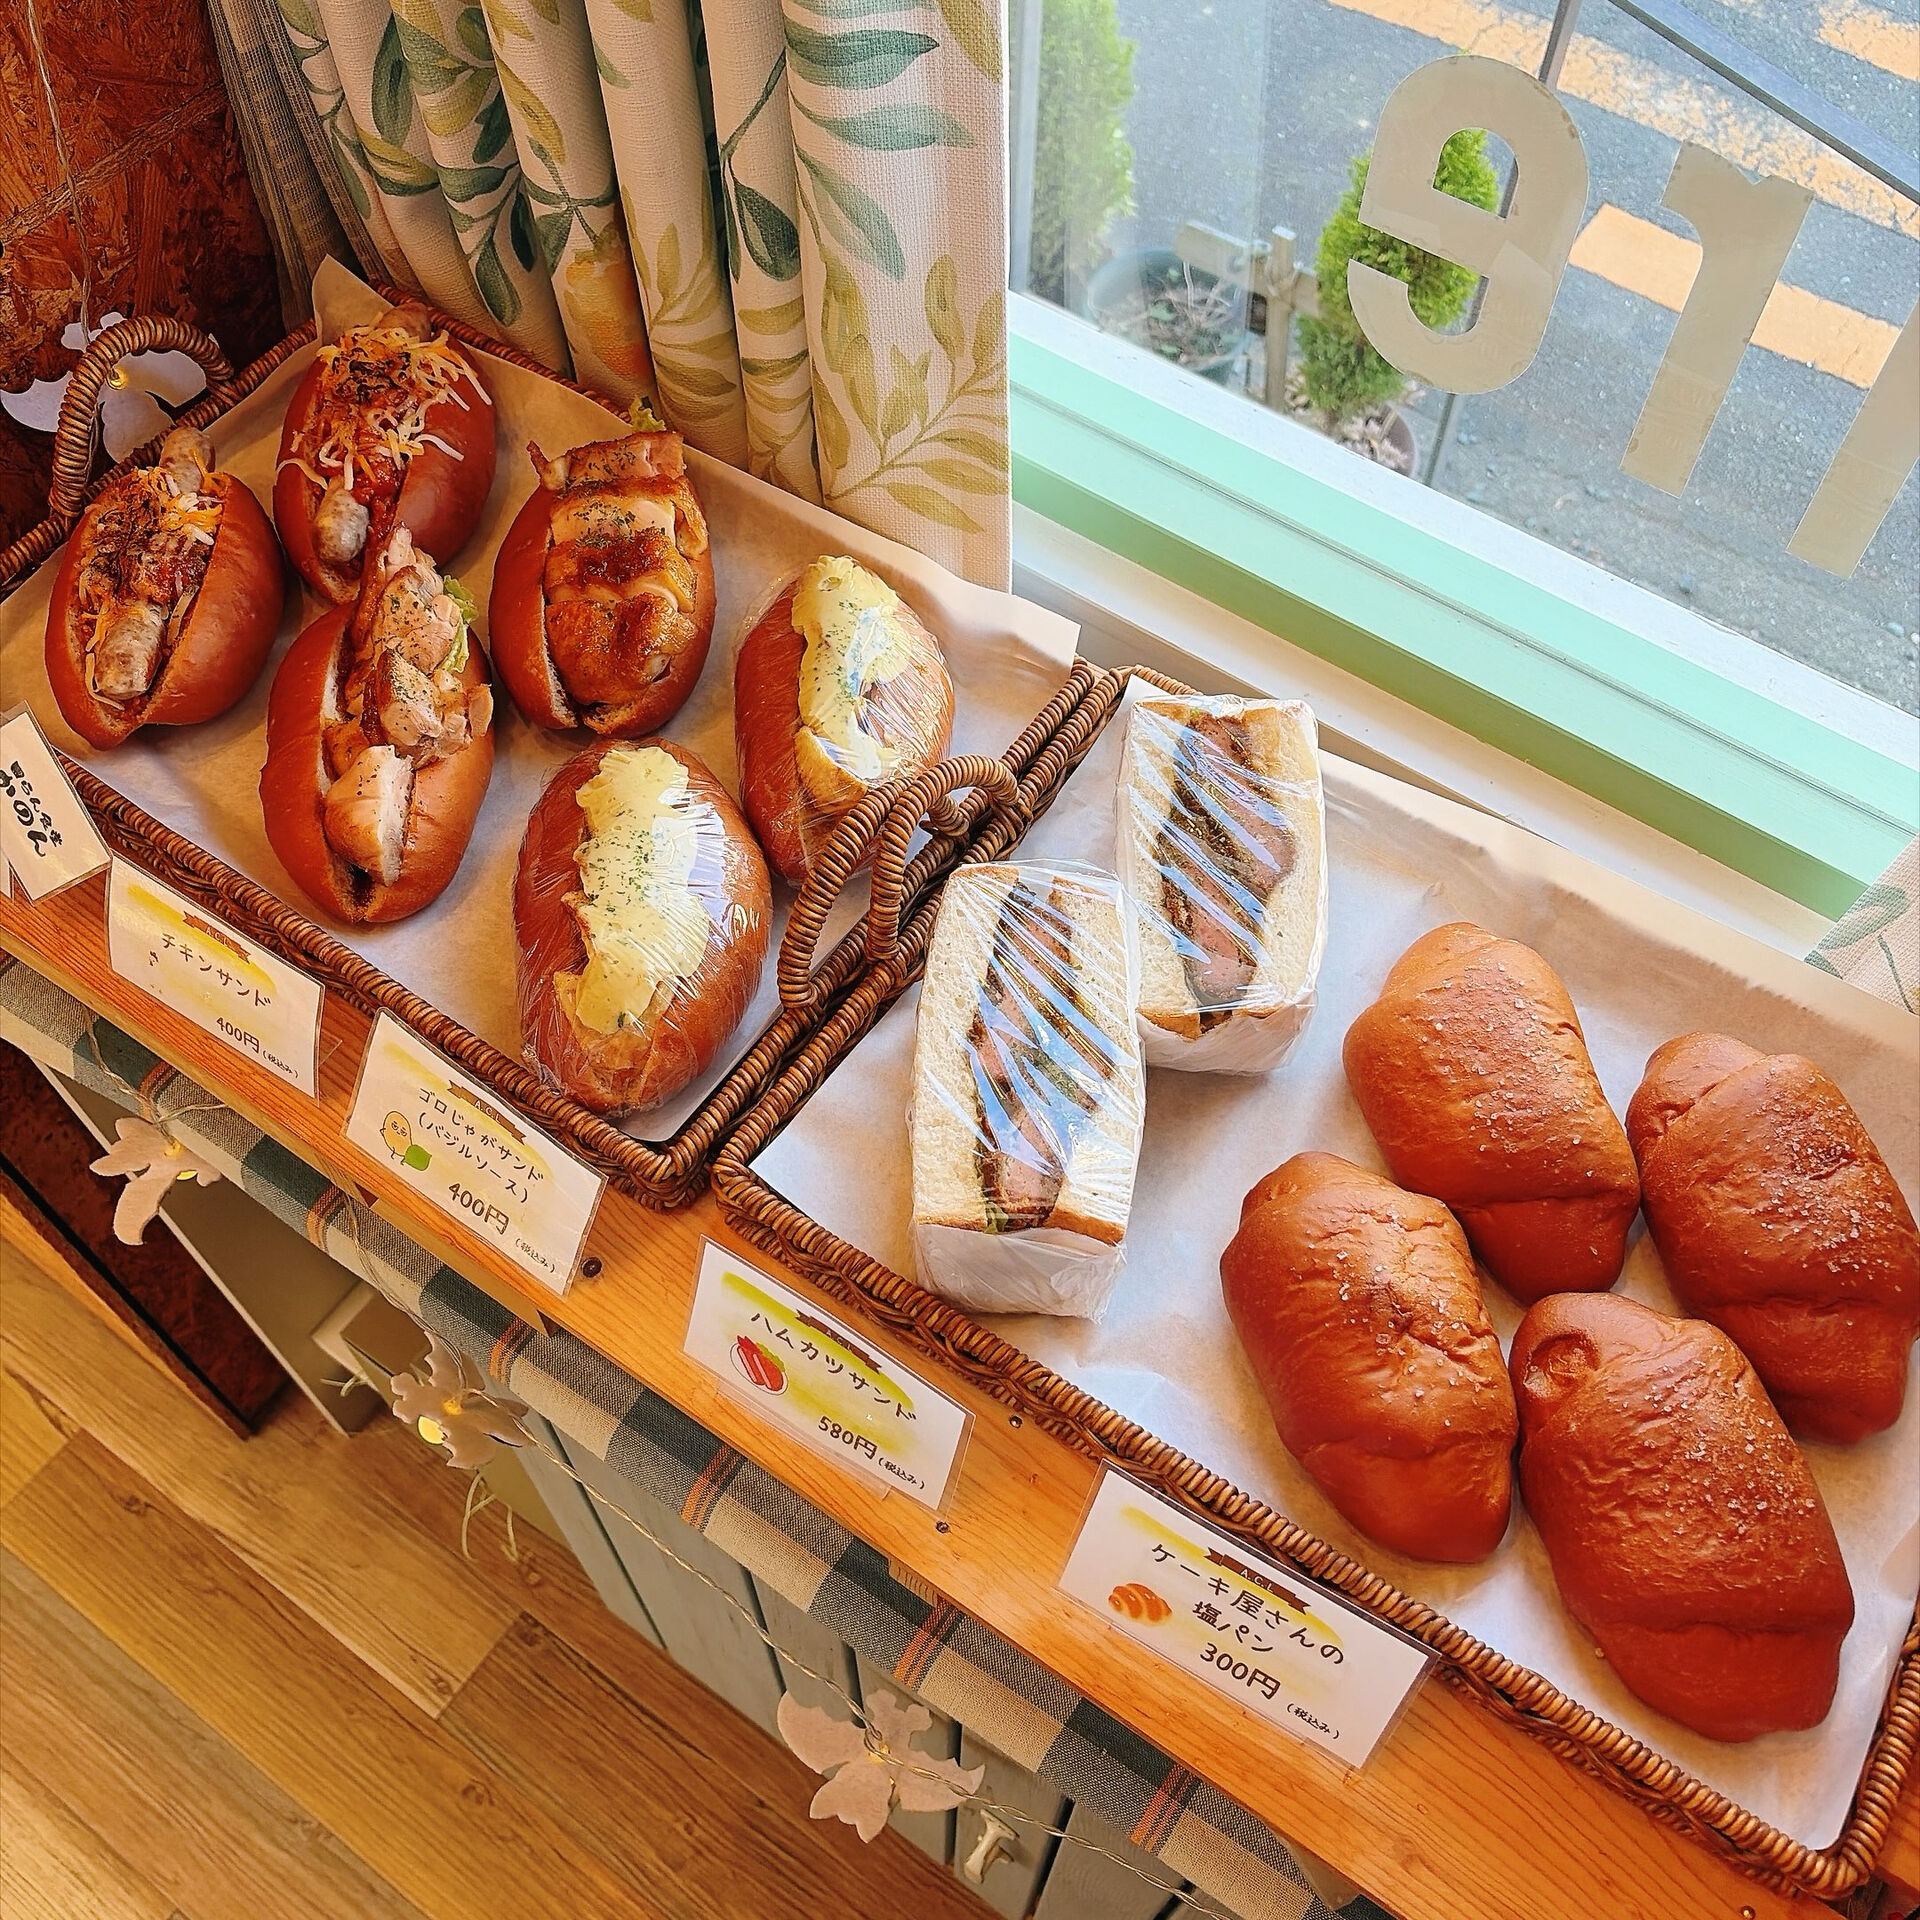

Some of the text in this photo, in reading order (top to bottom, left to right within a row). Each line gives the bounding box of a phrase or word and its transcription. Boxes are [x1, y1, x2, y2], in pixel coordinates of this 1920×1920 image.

[161, 932, 271, 1007] チキンサンド
[216, 1017, 260, 1054] 400円
[418, 1087, 544, 1183] ゴロじゃがサンド
[418, 1112, 529, 1204] （バジルソース）
[448, 1182, 510, 1236] 400円
[751, 1312, 917, 1422] ハムカツサンド
[818, 1415, 878, 1460] 580円
[1151, 1543, 1345, 1666] ケーキ屋さんの
[1192, 1600, 1275, 1653] 塩パン
[1200, 1642, 1281, 1700] 300円
